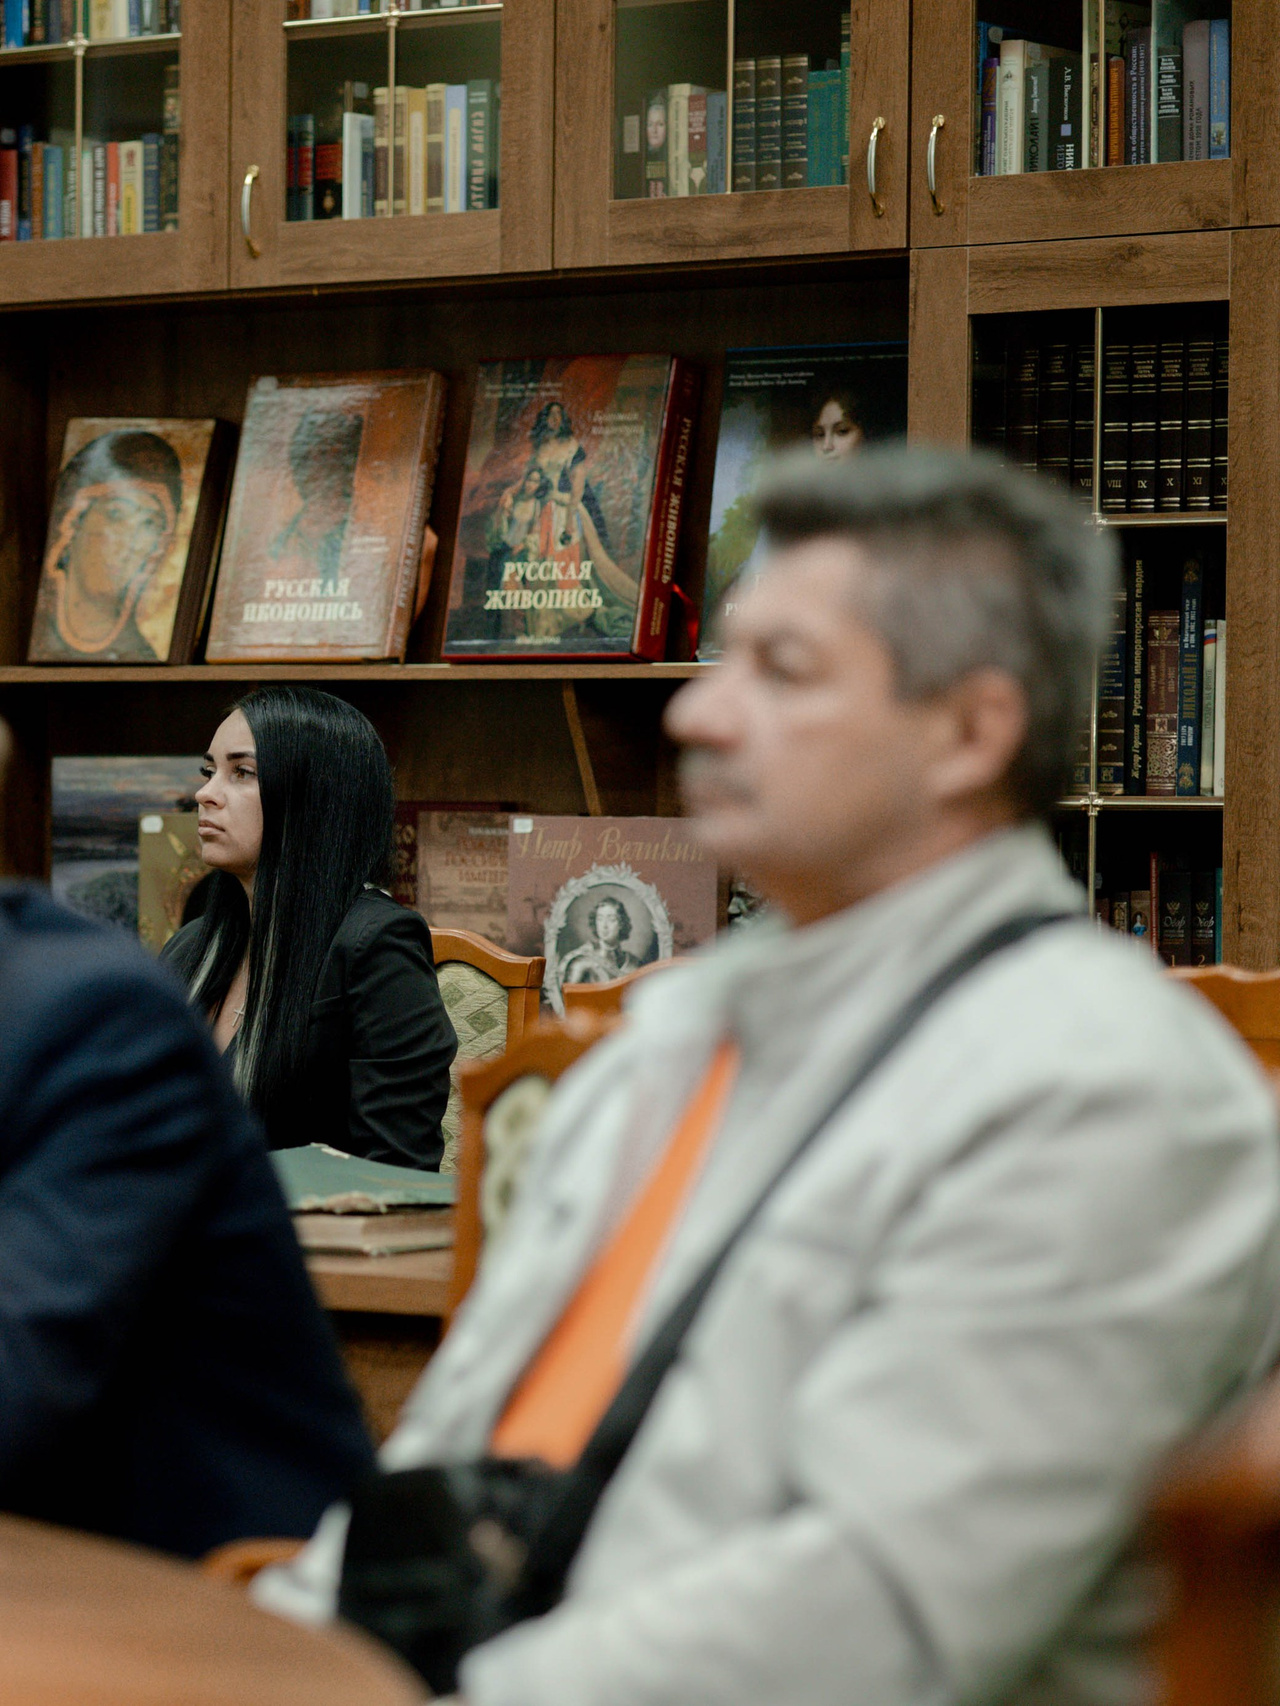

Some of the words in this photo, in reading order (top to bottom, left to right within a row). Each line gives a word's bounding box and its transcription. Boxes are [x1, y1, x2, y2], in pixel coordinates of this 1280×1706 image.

[1129, 82, 1138, 145] общественность
[672, 417, 692, 487] РУССКАЯ
[1107, 479, 1122, 488] VIII
[1137, 480, 1147, 488] IX
[1166, 478, 1174, 486] X
[1193, 477, 1202, 485] XI
[661, 492, 683, 584] ЖИВОПИСЬ
[503, 560, 594, 582] РУССКАЯ
[1134, 559, 1144, 599] гвардия
[263, 577, 351, 598] РУССКАЯ
[483, 588, 604, 610] ЖИВОПИСЬ
[242, 600, 364, 624] ИКОНОПИСЬ
[1133, 601, 1144, 675] императорская
[1184, 653, 1197, 662] II
[1132, 677, 1144, 716] Русская
[1181, 666, 1196, 719] НИКОЛАЙ
[1170, 954, 1176, 968] 1
[1197, 953, 1206, 968] 2
